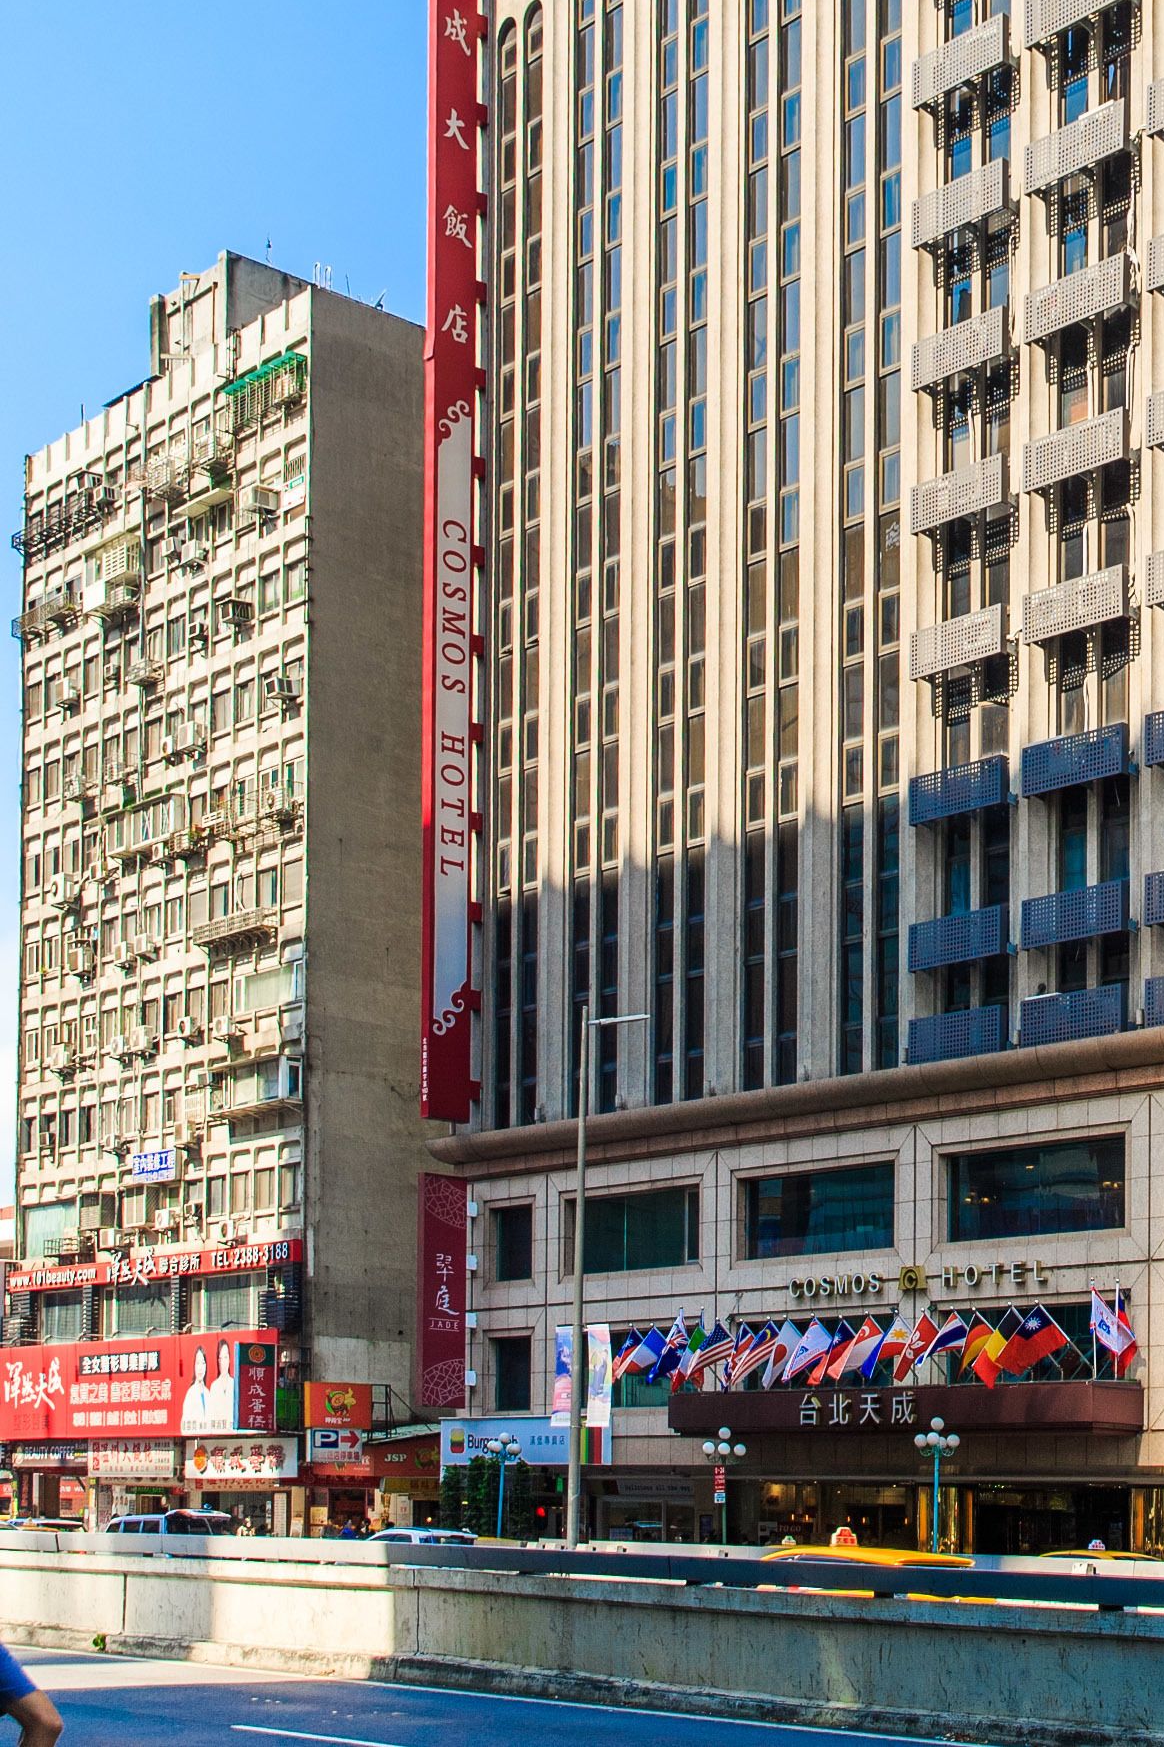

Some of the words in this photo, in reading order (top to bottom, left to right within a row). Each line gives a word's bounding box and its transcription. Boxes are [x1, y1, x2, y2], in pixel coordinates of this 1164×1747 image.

[442, 518, 468, 695] COSMOS
[439, 730, 465, 877] HOTEL
[158, 1252, 202, 1275] 聯合診所
[9, 1267, 98, 1288] www.101beauty.com
[435, 1252, 460, 1316] 翠庭
[787, 1271, 884, 1300] COSMOS
[941, 1259, 1049, 1288] HOTEL
[430, 1319, 459, 1331] JADE
[798, 1390, 918, 1427] 台北天成
[314, 1431, 338, 1447] P
[25, 1445, 49, 1461] BEAUTY
[50, 1445, 75, 1461] COFFEE
[384, 1453, 408, 1462] JSP
